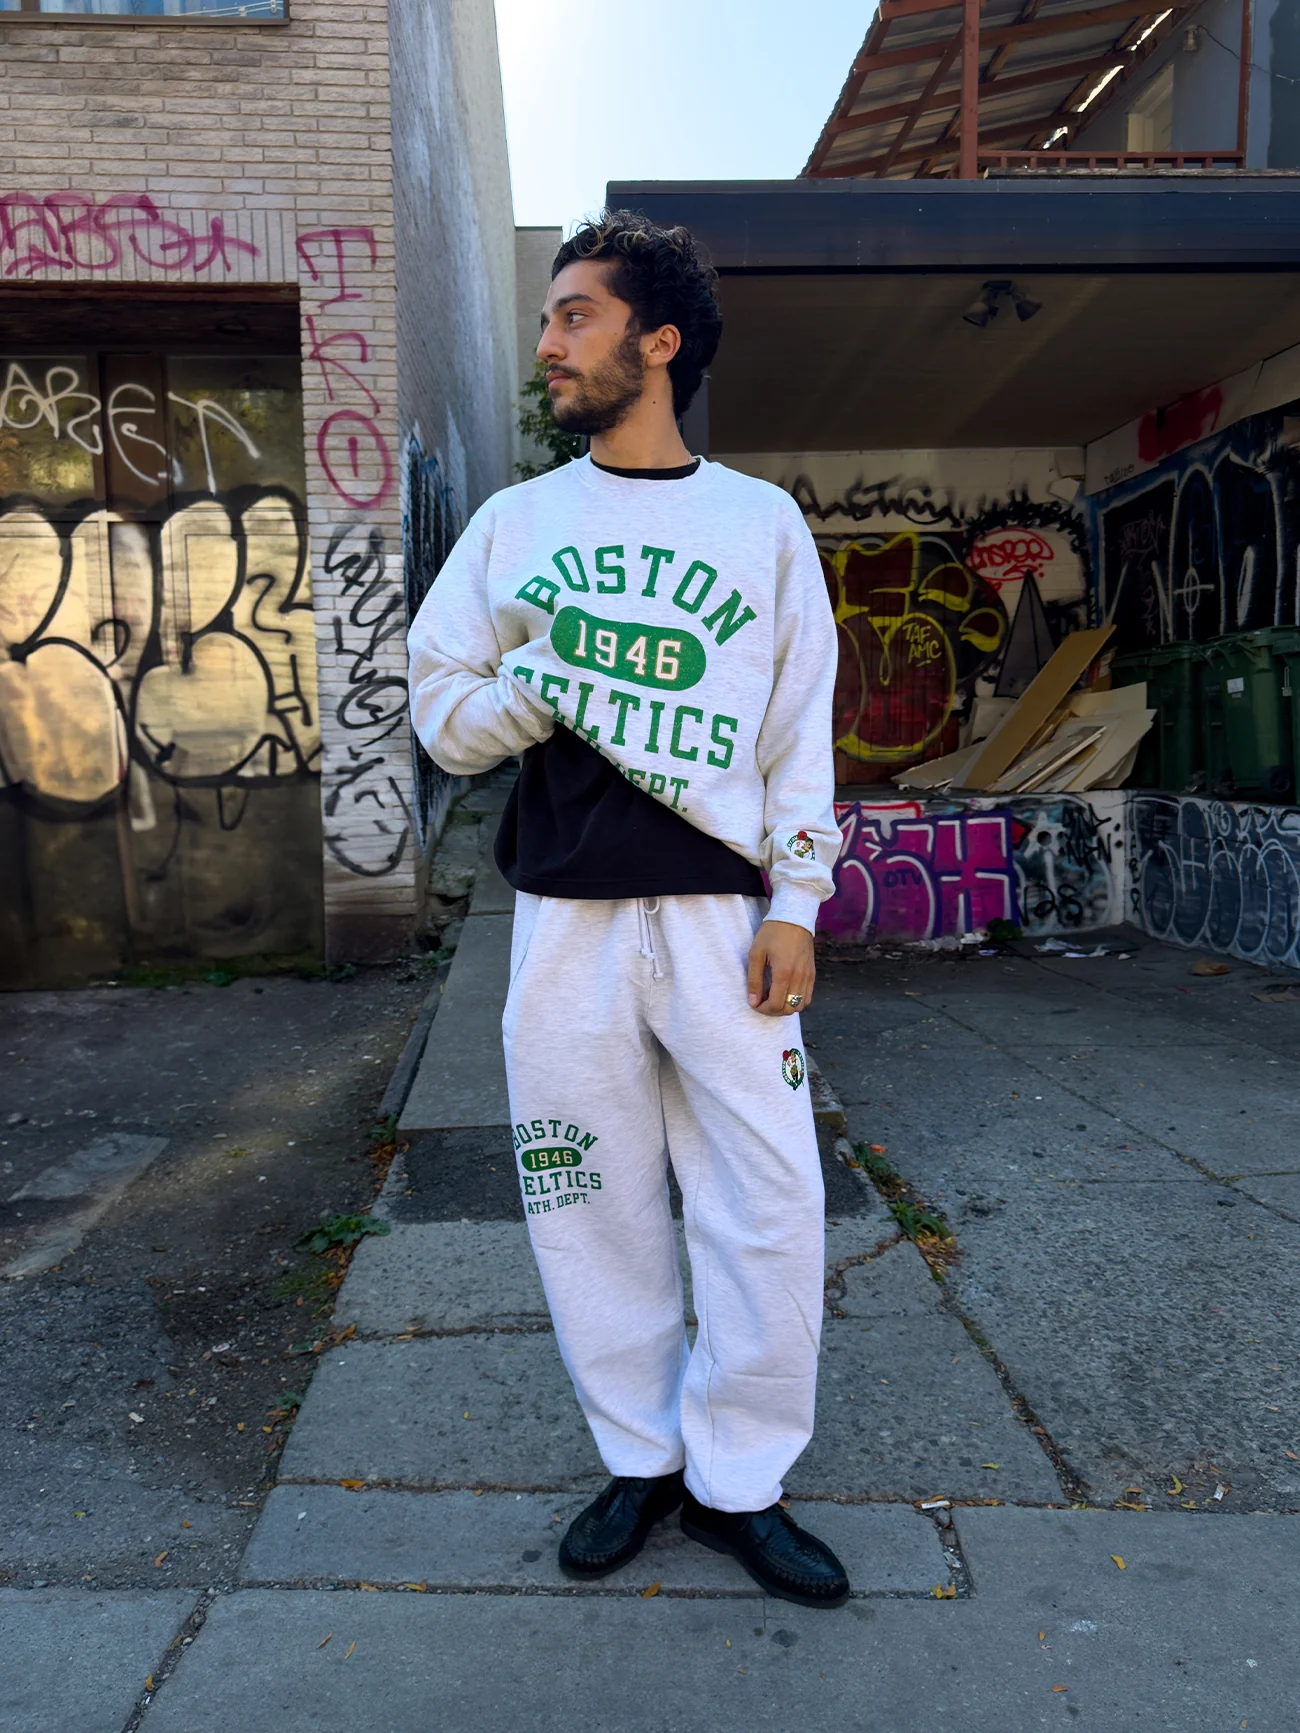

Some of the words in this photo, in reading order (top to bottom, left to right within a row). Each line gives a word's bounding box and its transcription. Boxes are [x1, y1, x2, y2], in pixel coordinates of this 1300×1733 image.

[515, 545, 757, 646] BOSTON
[574, 619, 682, 681] 1946
[617, 763, 690, 812] EPT.
[530, 1151, 573, 1169] 1946
[519, 1170, 602, 1196] ELTICS
[528, 1200, 555, 1215] ATH.
[556, 1192, 591, 1209] DEPT.
